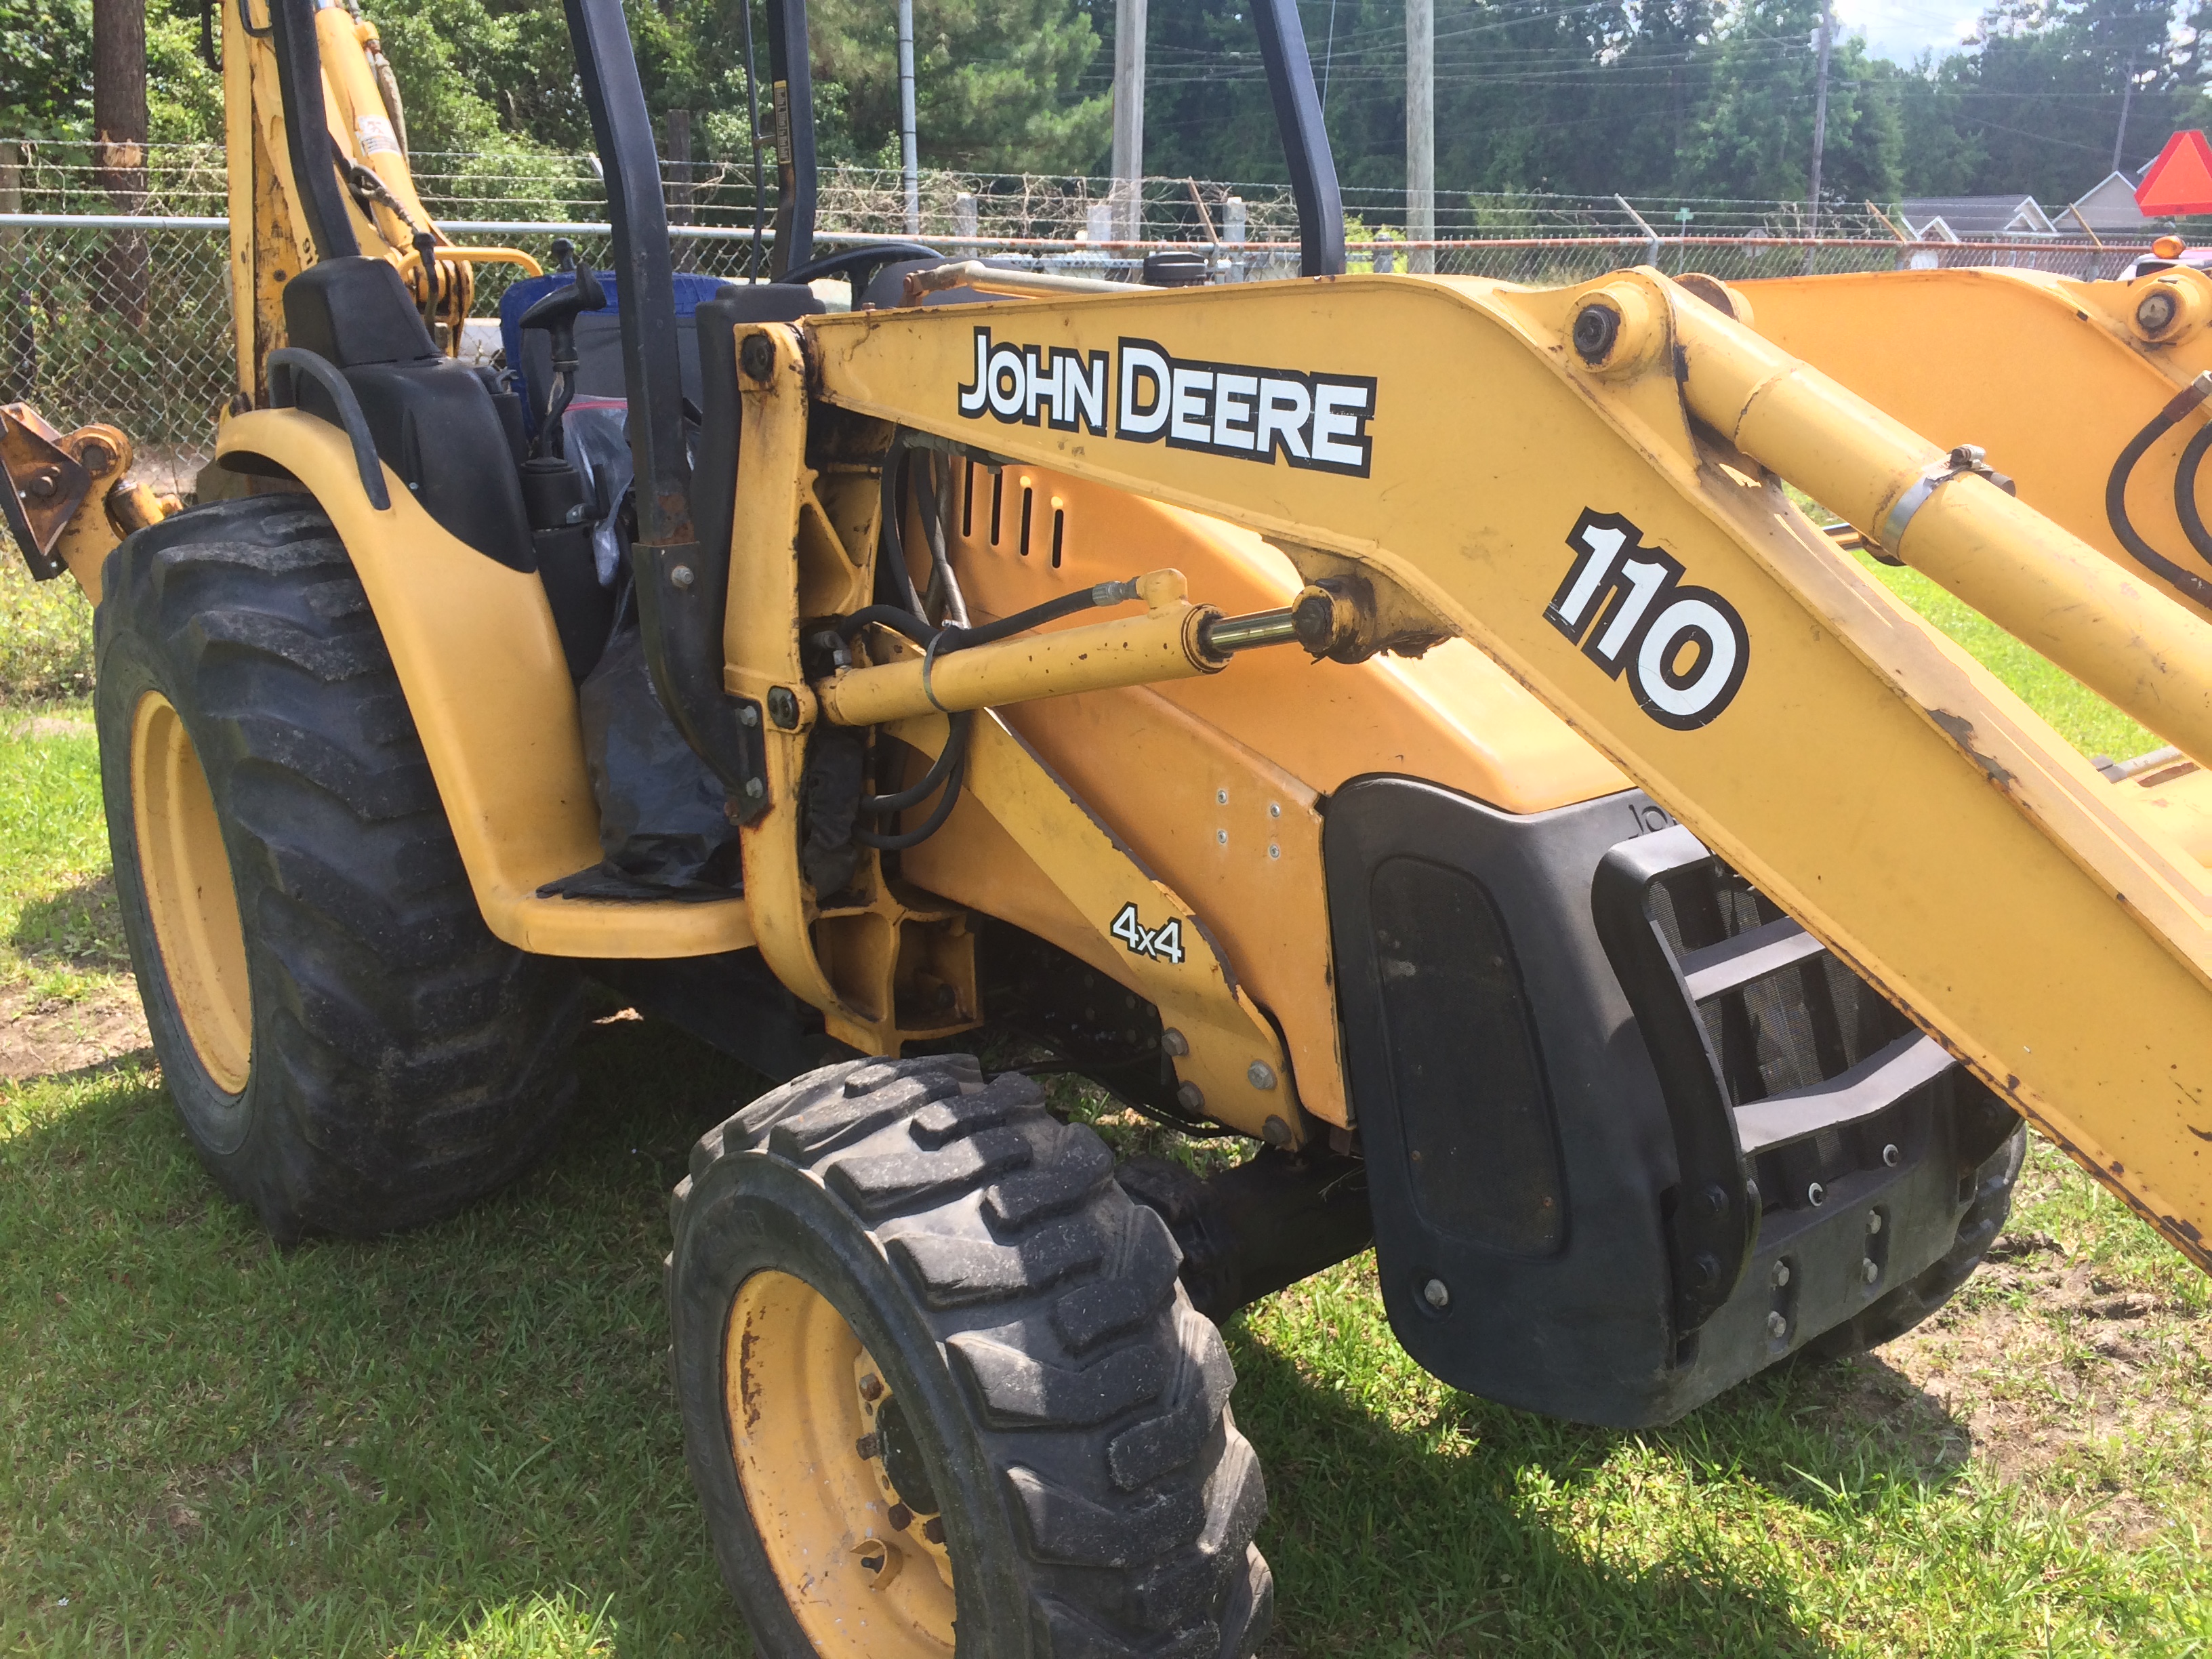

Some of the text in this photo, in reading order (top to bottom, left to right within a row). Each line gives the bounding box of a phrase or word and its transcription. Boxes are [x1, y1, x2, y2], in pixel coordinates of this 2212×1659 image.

[960, 331, 1372, 470] JOHN DEERE
[1554, 520, 1740, 720] 110
[1111, 904, 1183, 964] 4x4
